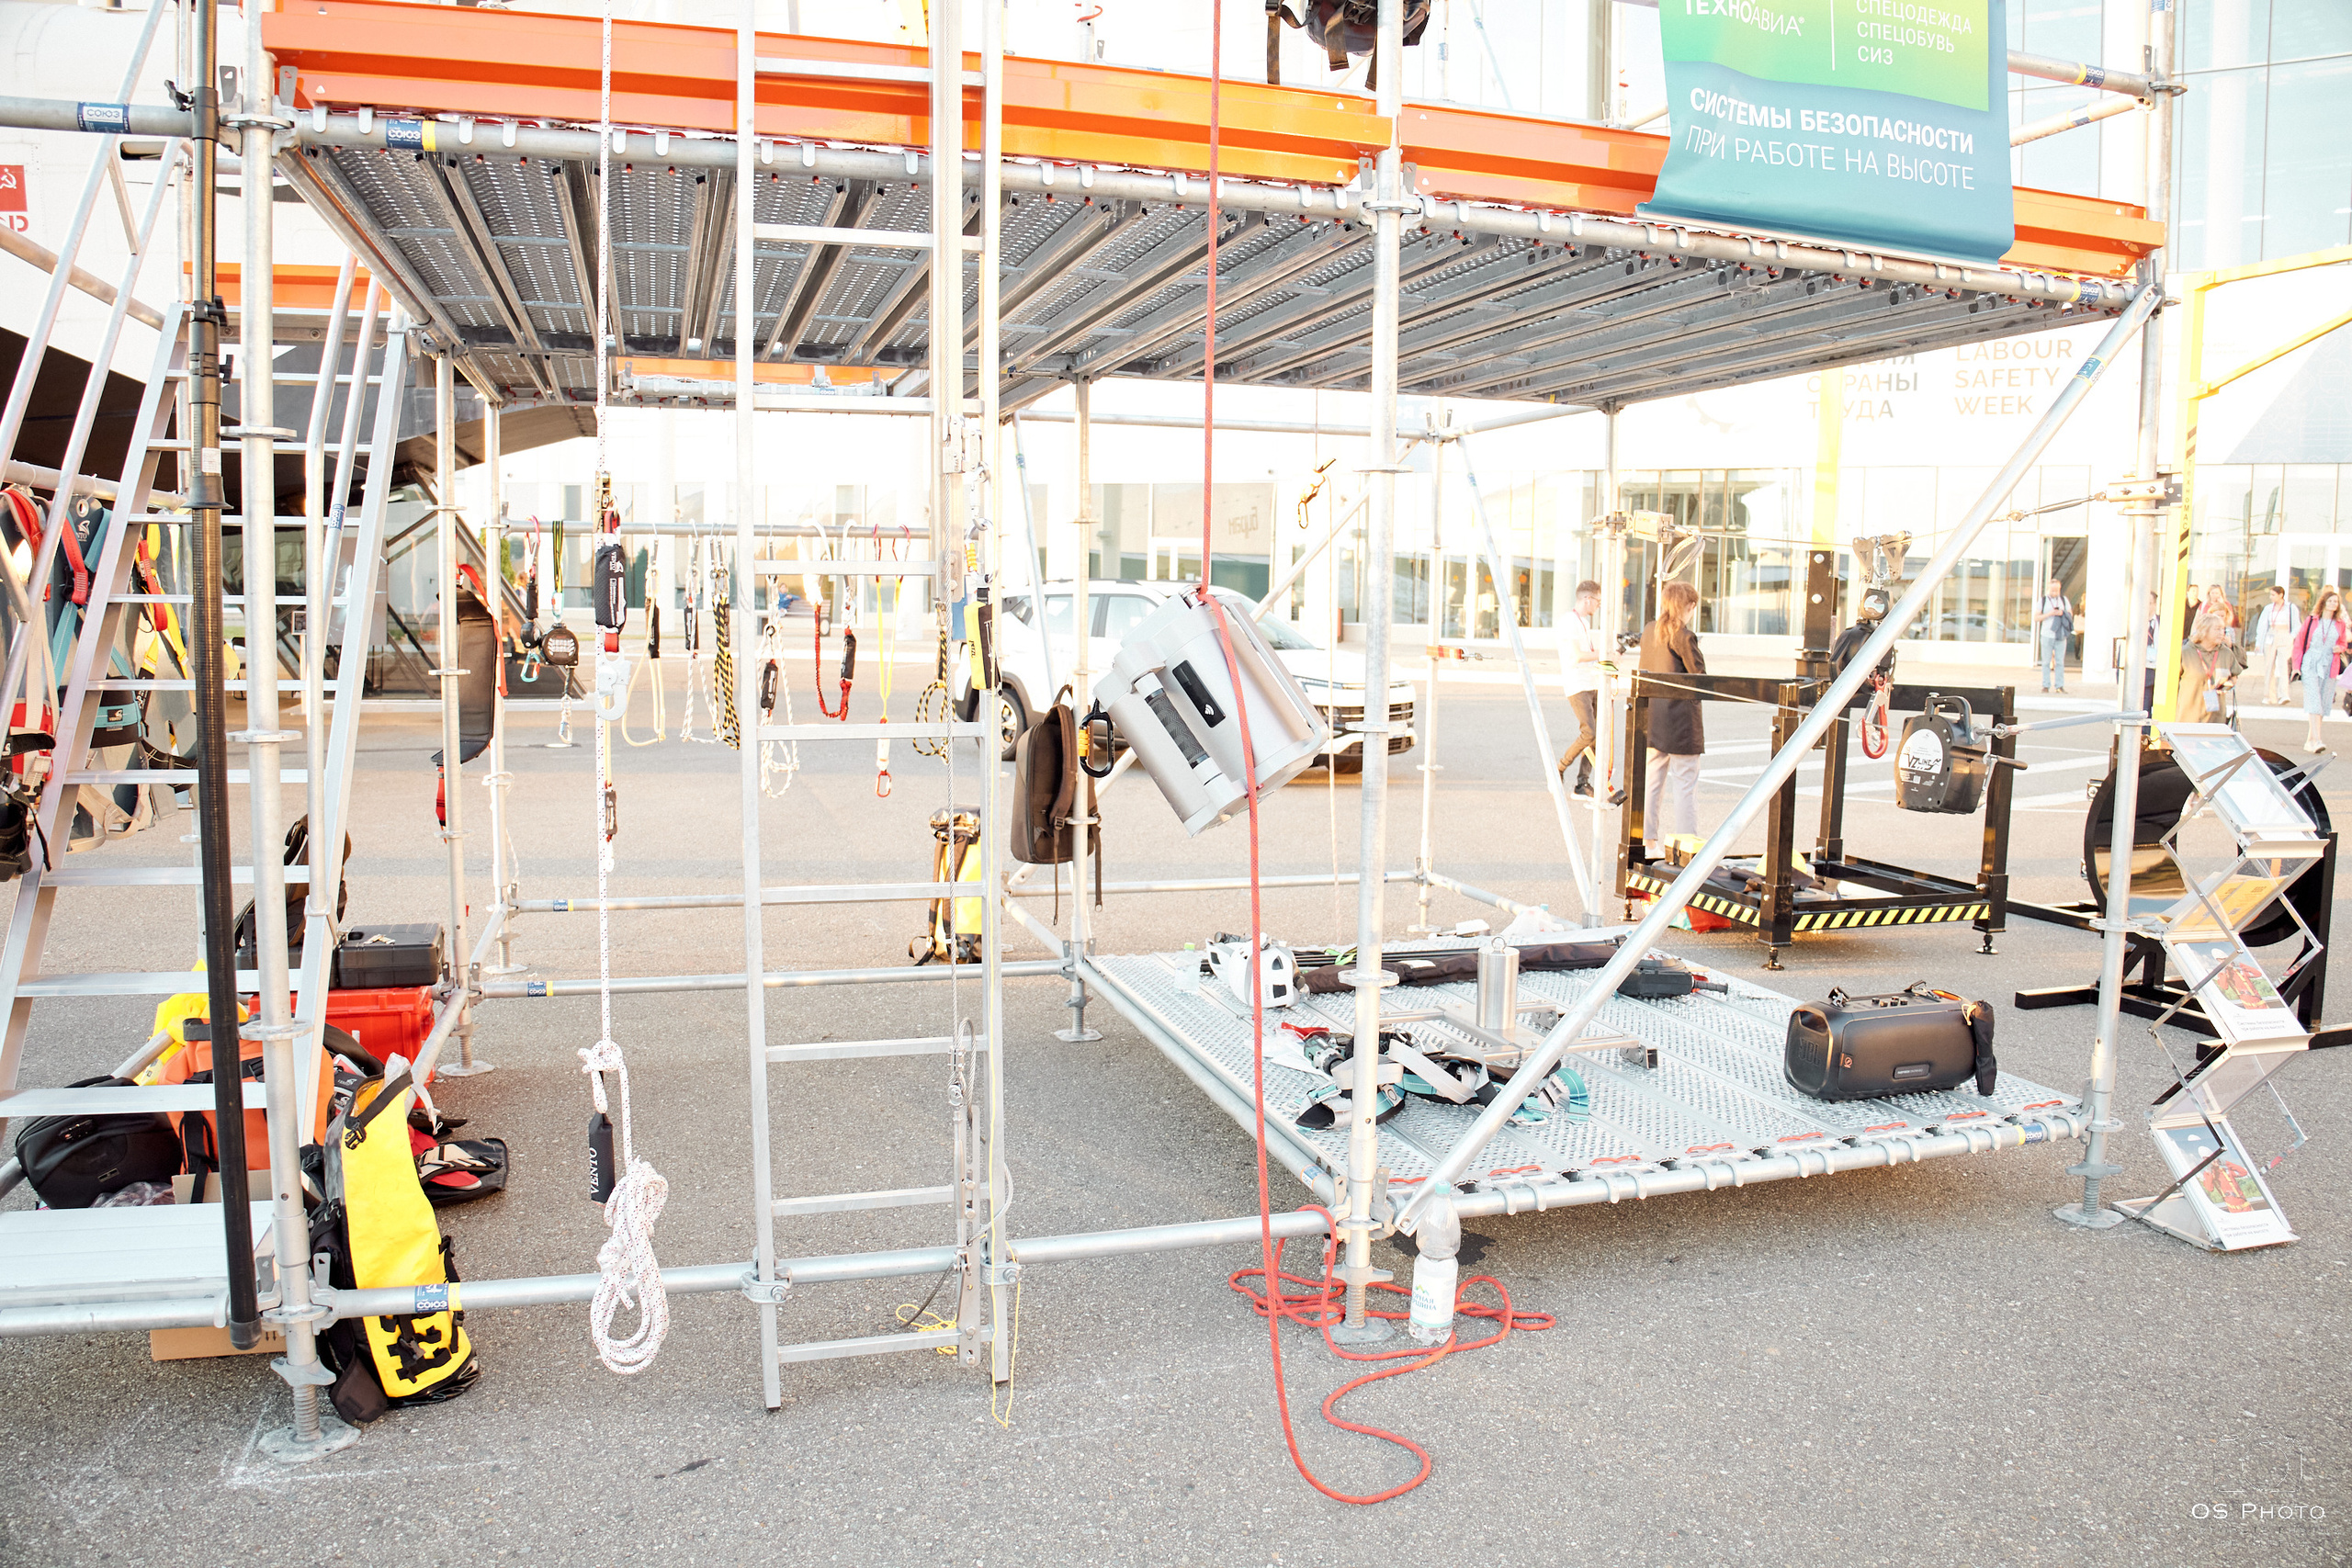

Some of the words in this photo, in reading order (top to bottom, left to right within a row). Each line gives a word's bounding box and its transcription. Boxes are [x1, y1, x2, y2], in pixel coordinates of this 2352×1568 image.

[1856, 0, 1973, 35] СПЕЦОДЕЖДА
[1857, 21, 1955, 53] СПЕЦОБУВЬ
[1858, 45, 1894, 65] СИЗ
[86, 108, 120, 118] СОЮЗ
[1690, 87, 1792, 130] СИСТЕМЫ
[1800, 108, 1973, 154] БЕЗОПАСНОСТИ
[388, 129, 422, 140] СОЮЗ
[1685, 125, 1725, 159] ПРИ
[1735, 137, 1836, 171] РАБОТЕ
[1845, 148, 1879, 176] НА
[1887, 153, 1974, 190] ВЫСОТЕ
[1955, 339, 2073, 362] LABOUR
[1807, 372, 1918, 393] ОРАНЫ
[1955, 367, 2061, 389] SAFETY
[1808, 400, 1894, 422] ТУДА
[1955, 395, 2033, 416] WEEK
[1798, 1037, 1820, 1066] JBL
[589, 1146, 600, 1194] VENTO
